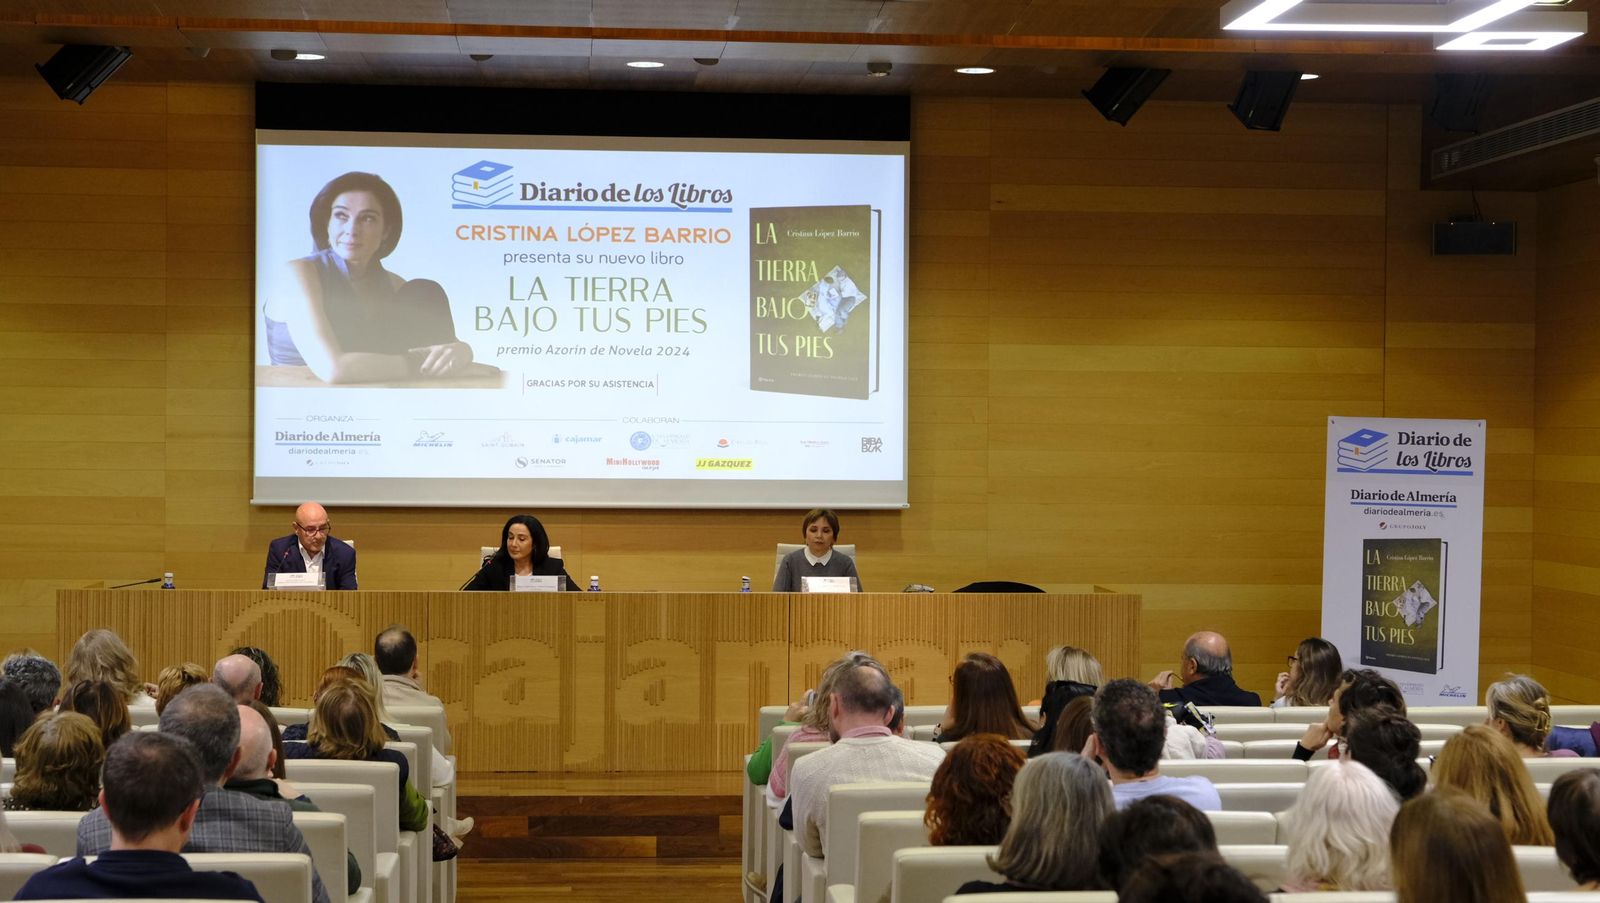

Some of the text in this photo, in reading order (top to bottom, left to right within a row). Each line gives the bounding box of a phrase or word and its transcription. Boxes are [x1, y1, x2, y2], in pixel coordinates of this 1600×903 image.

[520, 182, 733, 209] Diario de los Libros
[455, 223, 732, 244] CRISTINA LÓPEZ BARRIO
[755, 222, 860, 245] LA Cristina López Barrio
[503, 252, 684, 266] presenta su nuevo libro
[755, 259, 819, 282] TIERRA
[509, 276, 674, 303] LA TIERRA
[756, 296, 809, 320] BAJO
[474, 305, 708, 337] BAJO TUS PIES
[496, 345, 542, 357] premio
[590, 345, 606, 356] de
[608, 345, 653, 357] Novela
[656, 346, 691, 357] 2024
[755, 333, 834, 359] TUS PIES
[526, 379, 655, 389] GRACIAS POR SU ASISTENCIA
[305, 415, 354, 423] ORGANIZA
[622, 416, 680, 424] COLABORAN
[275, 431, 381, 442] Diario de Almería
[565, 434, 603, 444] cajamar
[1397, 431, 1472, 447] Diario de
[696, 460, 753, 468] JJ GAZQUEZ
[1396, 450, 1472, 473] los Libros
[1350, 489, 1457, 503] Diario de Almería
[1363, 507, 1444, 518] diariodealmeria.es
[1366, 549, 1381, 565] LA
[1366, 575, 1407, 591] TIERRA
[1365, 600, 1399, 617] BAJO
[1364, 626, 1415, 645] TUS PIES
